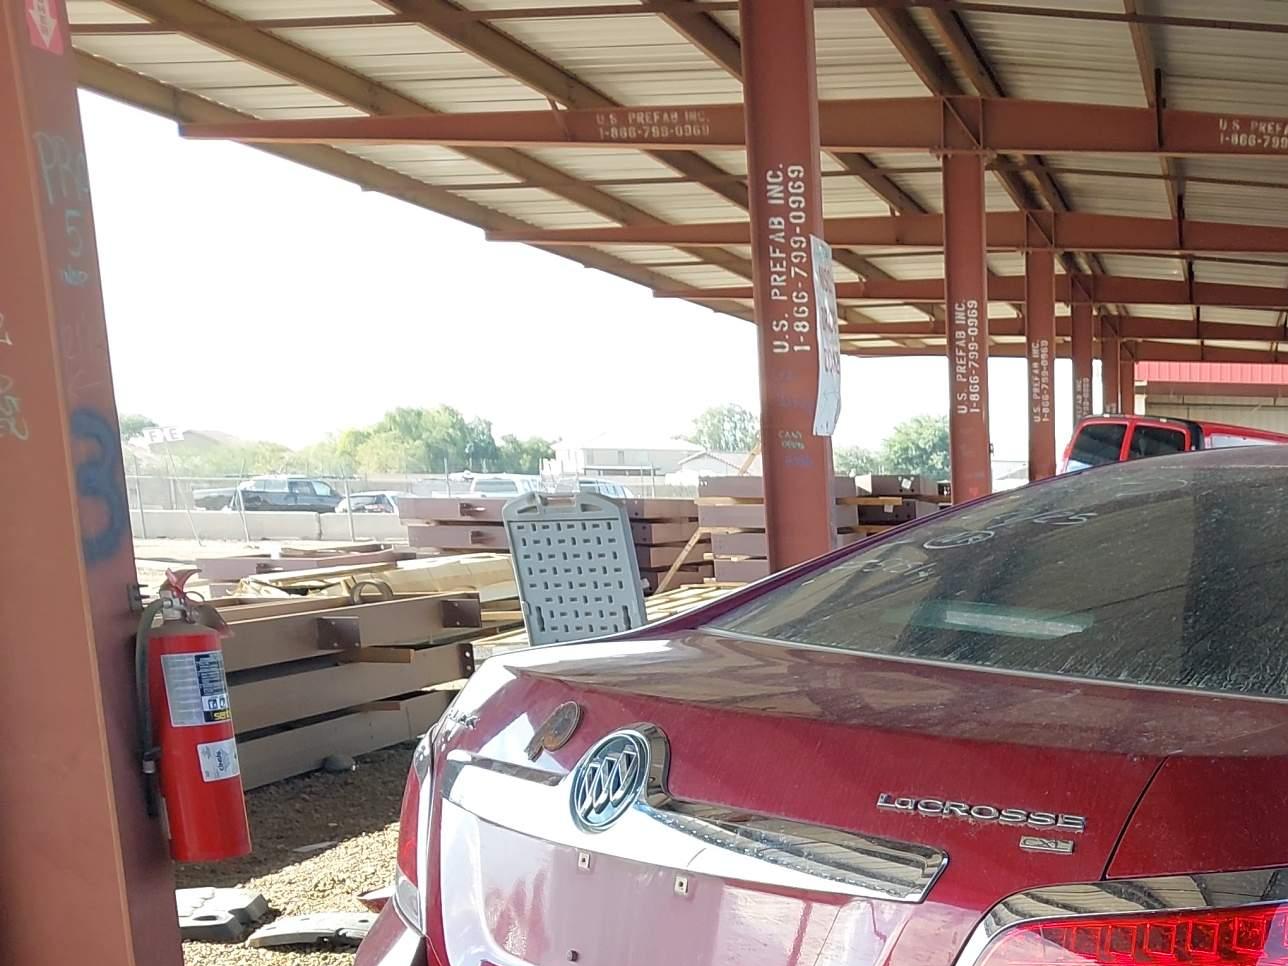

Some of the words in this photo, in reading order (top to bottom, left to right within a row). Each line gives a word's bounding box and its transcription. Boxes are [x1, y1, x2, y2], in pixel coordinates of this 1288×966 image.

[766, 163, 785, 205] INC.
[768, 216, 788, 301] PREFAB
[787, 164, 812, 353] 1-866-799-0969
[772, 314, 789, 354] U.S.
[955, 330, 967, 382] PREFAB
[966, 299, 981, 414] 1-866-799-0969
